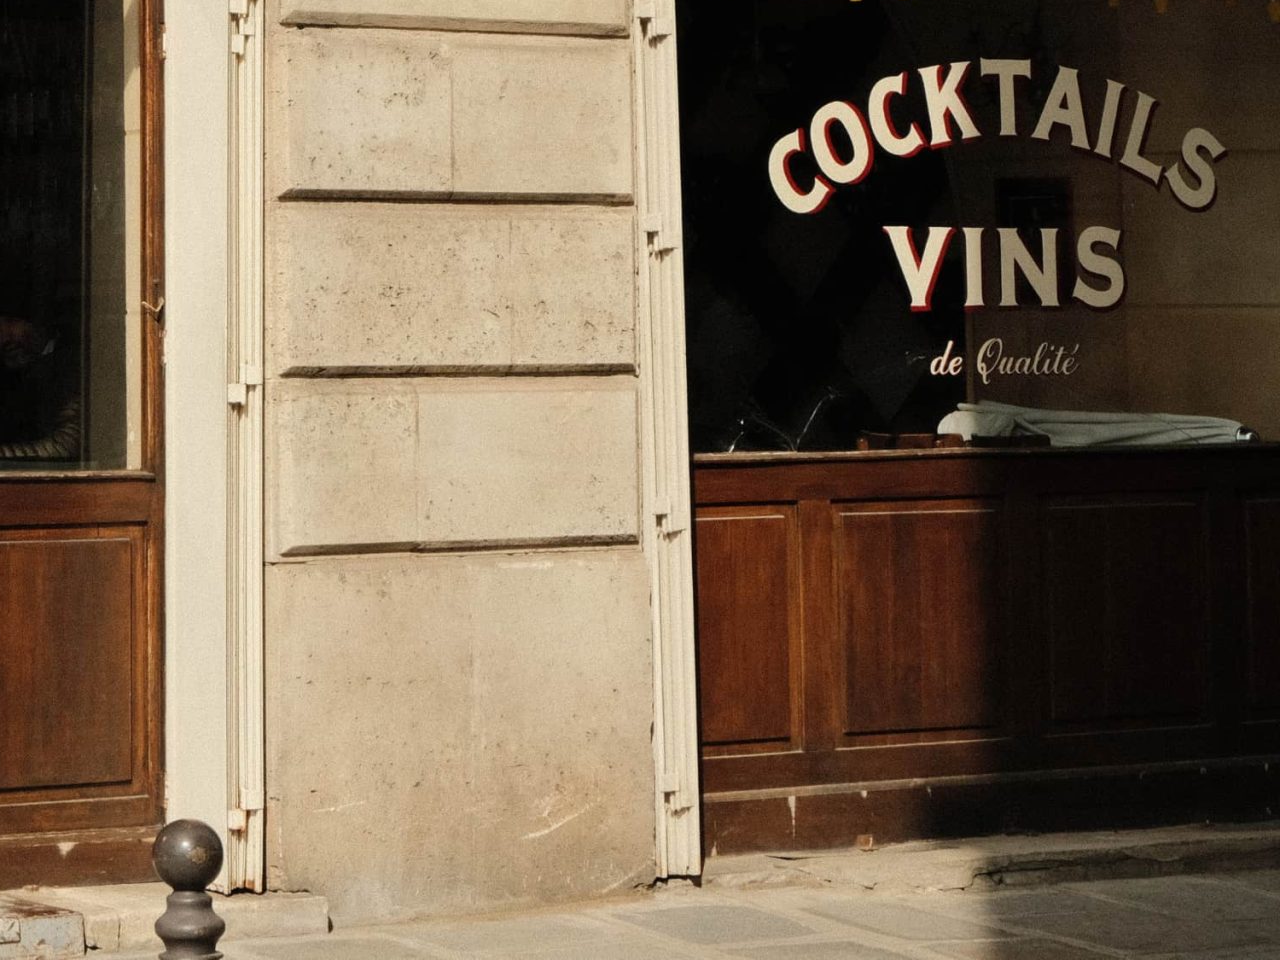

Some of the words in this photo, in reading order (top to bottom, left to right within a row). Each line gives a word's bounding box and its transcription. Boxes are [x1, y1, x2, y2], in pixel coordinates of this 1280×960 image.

[768, 57, 1227, 214] COCKTAILS
[883, 225, 1128, 312] VINS
[930, 340, 963, 376] de
[976, 338, 1080, 385] Qualité
